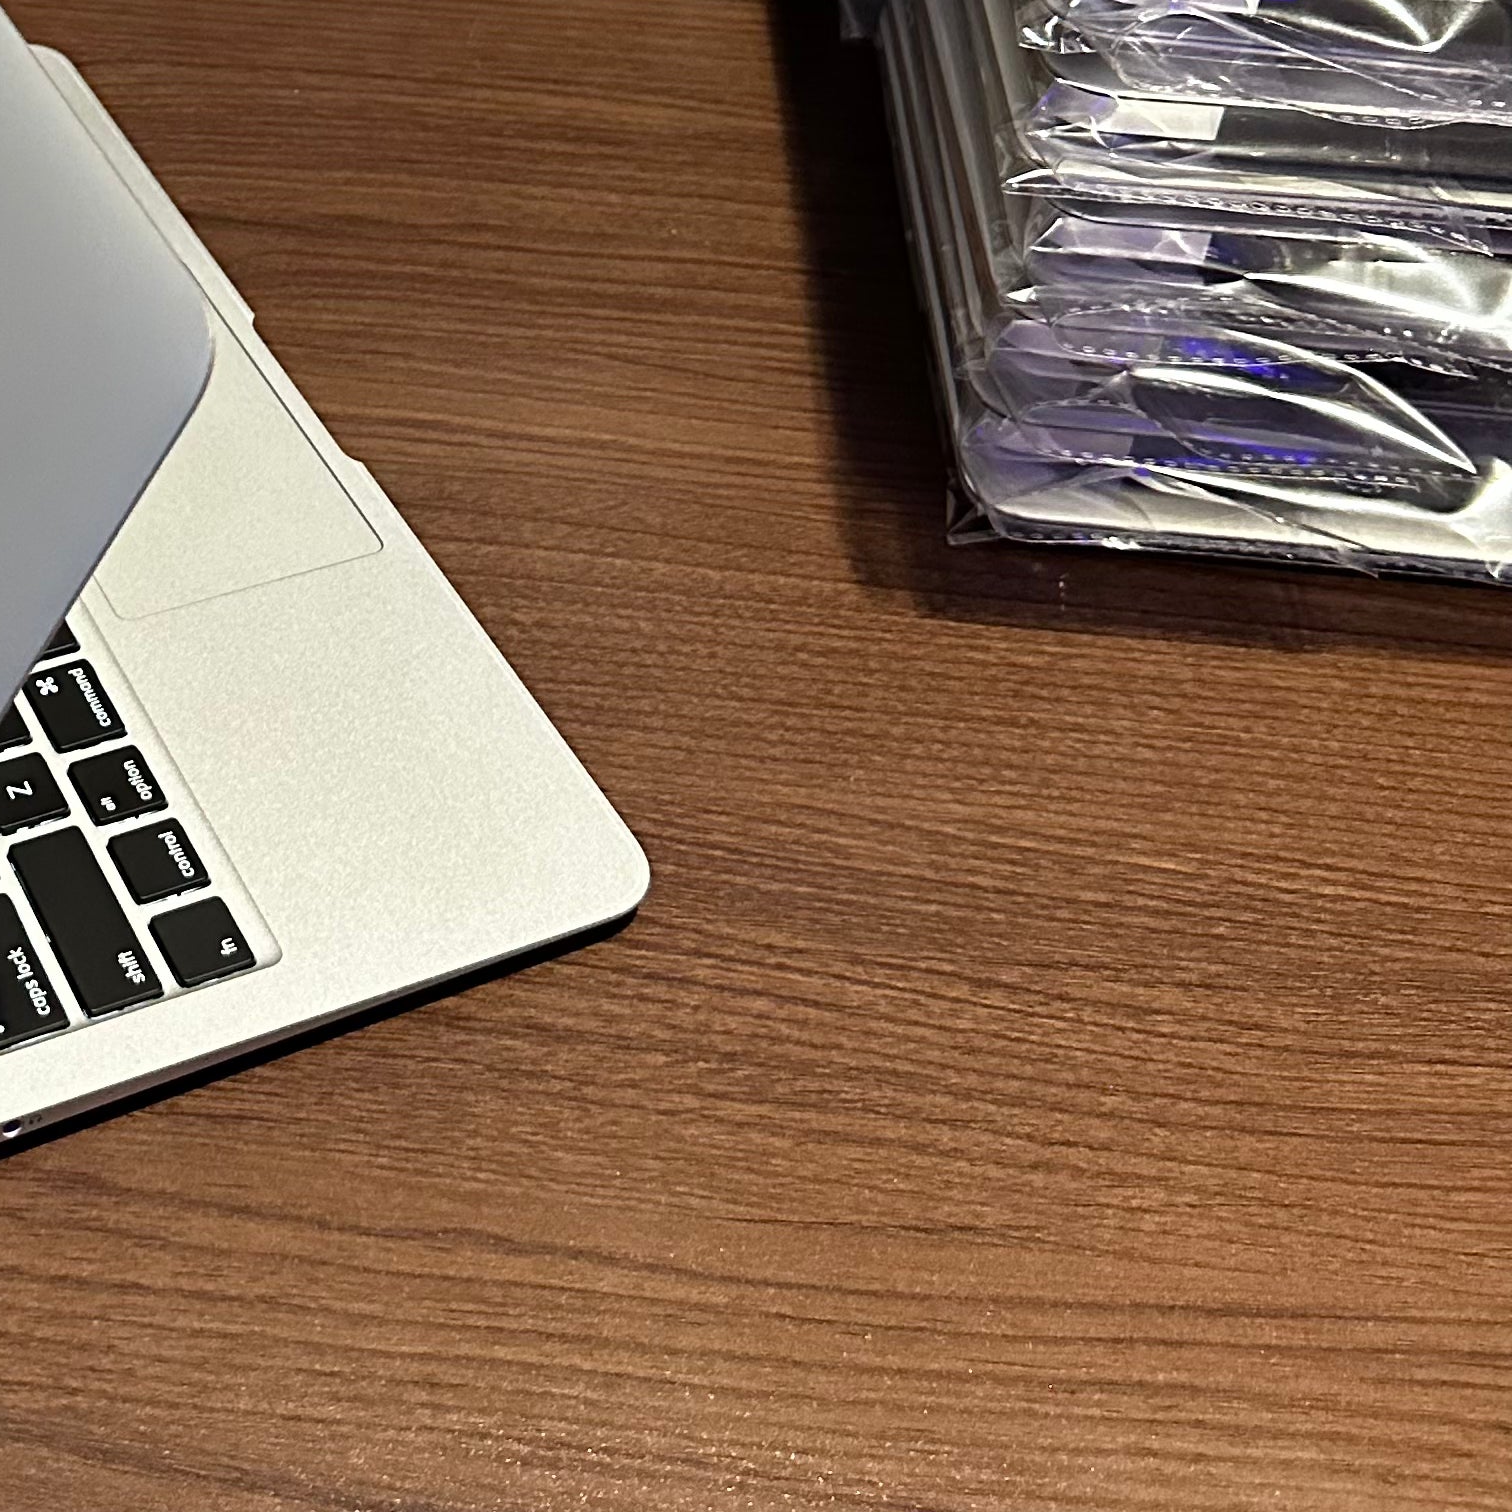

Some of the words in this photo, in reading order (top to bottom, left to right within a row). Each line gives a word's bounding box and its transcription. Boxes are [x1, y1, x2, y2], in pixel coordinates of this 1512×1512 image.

[68, 667, 112, 727] command
[5, 780, 33, 800] Z
[123, 759, 153, 801] option
[157, 830, 195, 878] control
[7, 946, 34, 980] lock
[220, 937, 238, 956] fn
[117, 950, 146, 985] shift
[25, 979, 51, 1016] caps
